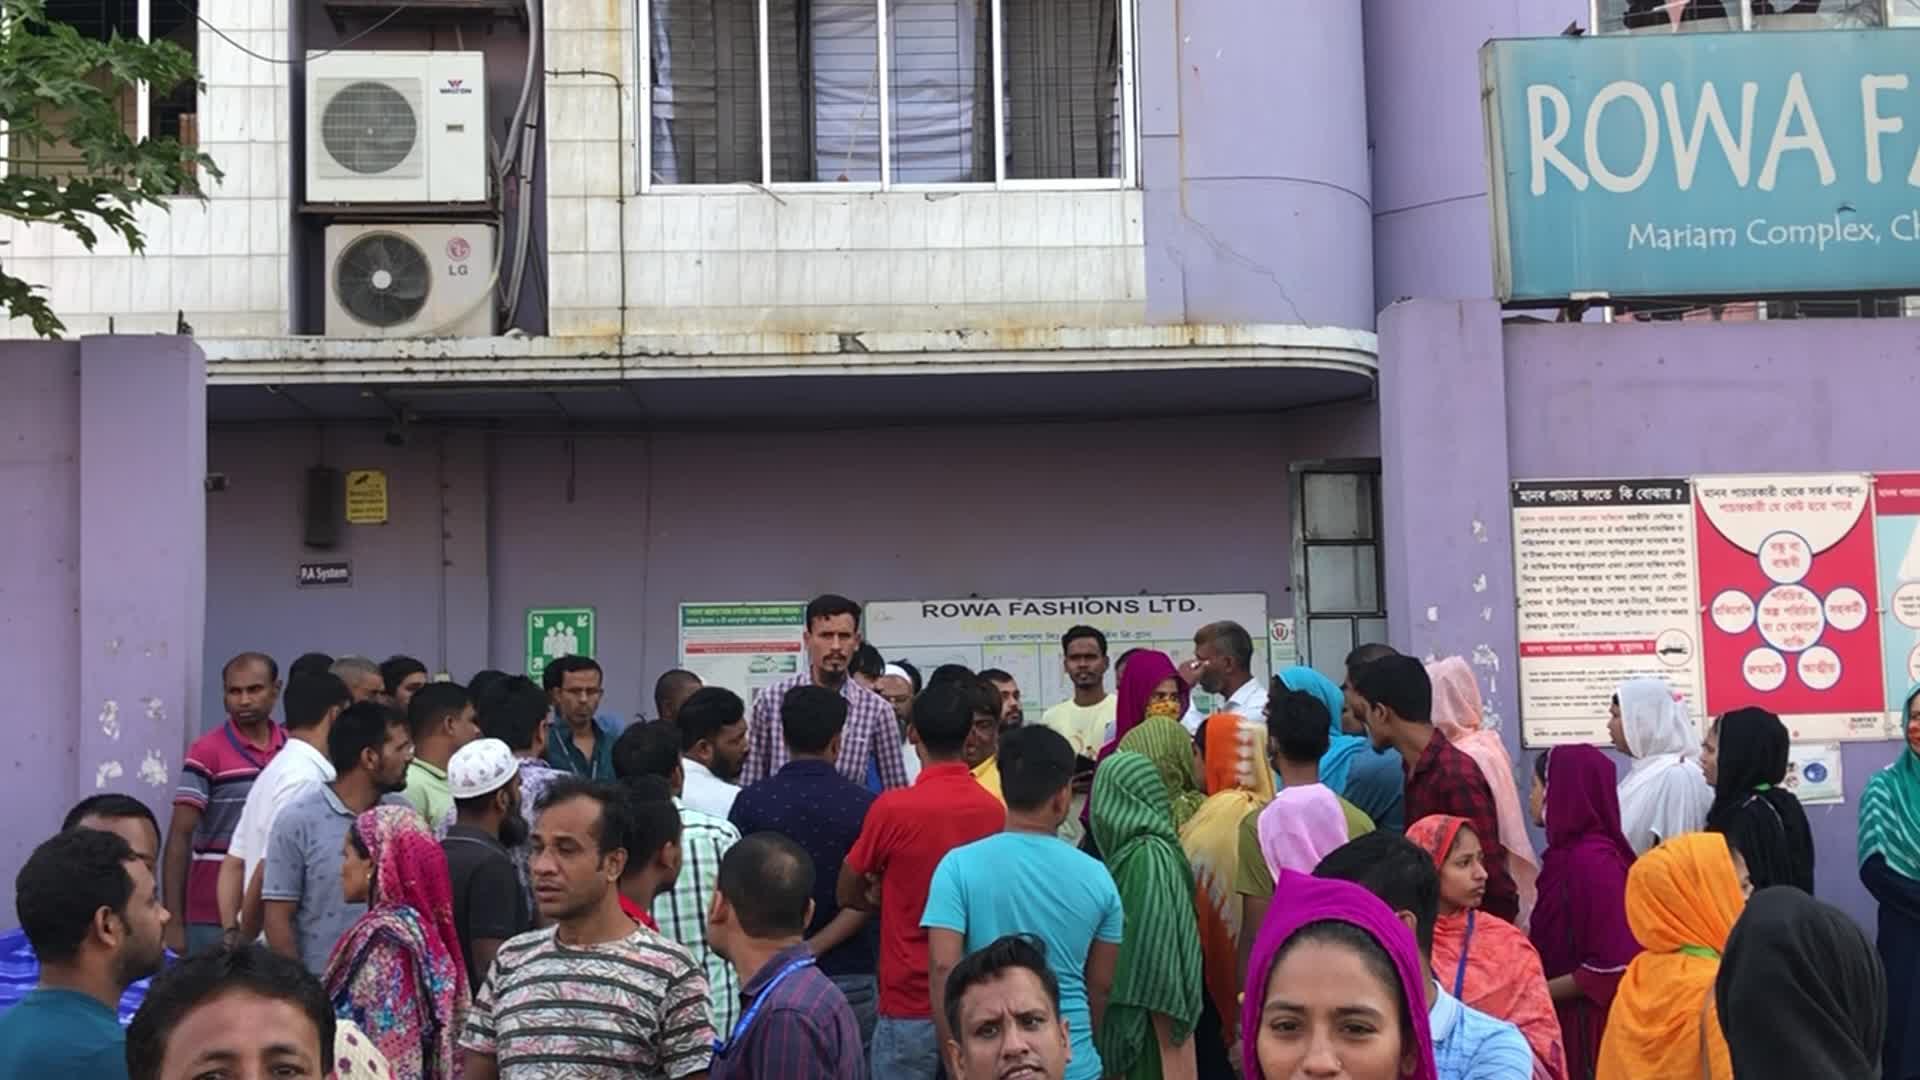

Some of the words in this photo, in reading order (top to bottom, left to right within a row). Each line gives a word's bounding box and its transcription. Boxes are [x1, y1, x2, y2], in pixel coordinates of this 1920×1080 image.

[1527, 72, 1836, 196] ROWA
[1861, 73, 1920, 190] F
[1628, 222, 1736, 251] Mariam
[1746, 215, 1881, 252] Complex,
[449, 265, 468, 276] LG
[922, 603, 1001, 618] ROWA
[1009, 600, 1139, 616] FASHIONS
[1148, 598, 1203, 613] LTD.
